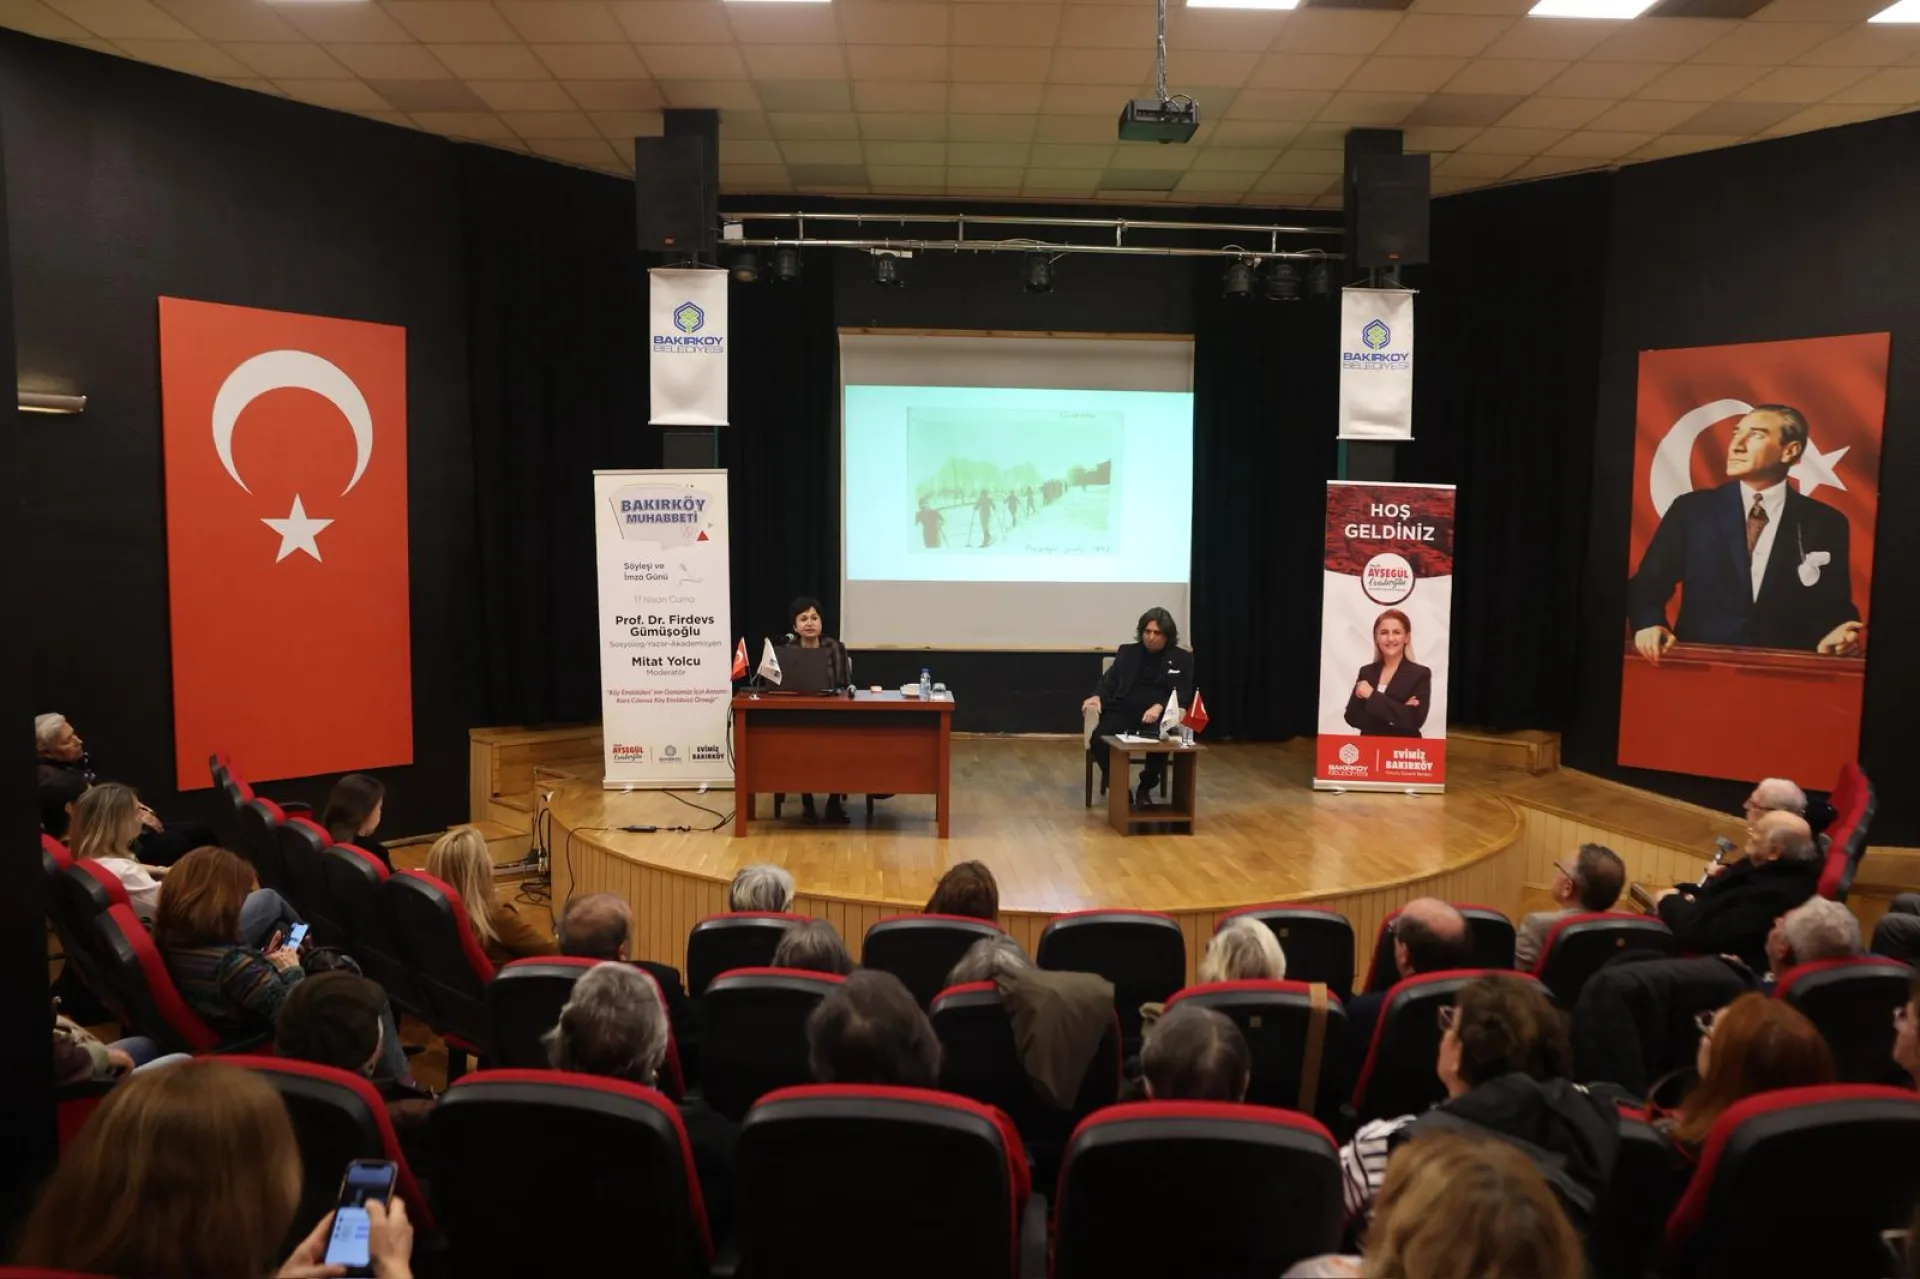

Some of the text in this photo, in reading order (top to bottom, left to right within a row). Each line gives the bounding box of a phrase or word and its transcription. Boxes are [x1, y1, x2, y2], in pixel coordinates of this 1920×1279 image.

[621, 495, 706, 512] BAKIRKÖY
[1370, 503, 1411, 520] HOŞ
[626, 511, 698, 524] MUHABBETİ
[1344, 522, 1435, 541] GELDİNİZ
[623, 562, 653, 571] Söyleşi
[623, 572, 668, 581] İmza Günü
[615, 614, 715, 625] Prof. Dr. Firdevs
[630, 626, 701, 637] Gümüşoğlu
[631, 656, 701, 667] Mitat Yolcu
[1393, 748, 1426, 760] EVİMİZ
[1385, 760, 1433, 771] BAKIRKÖY
